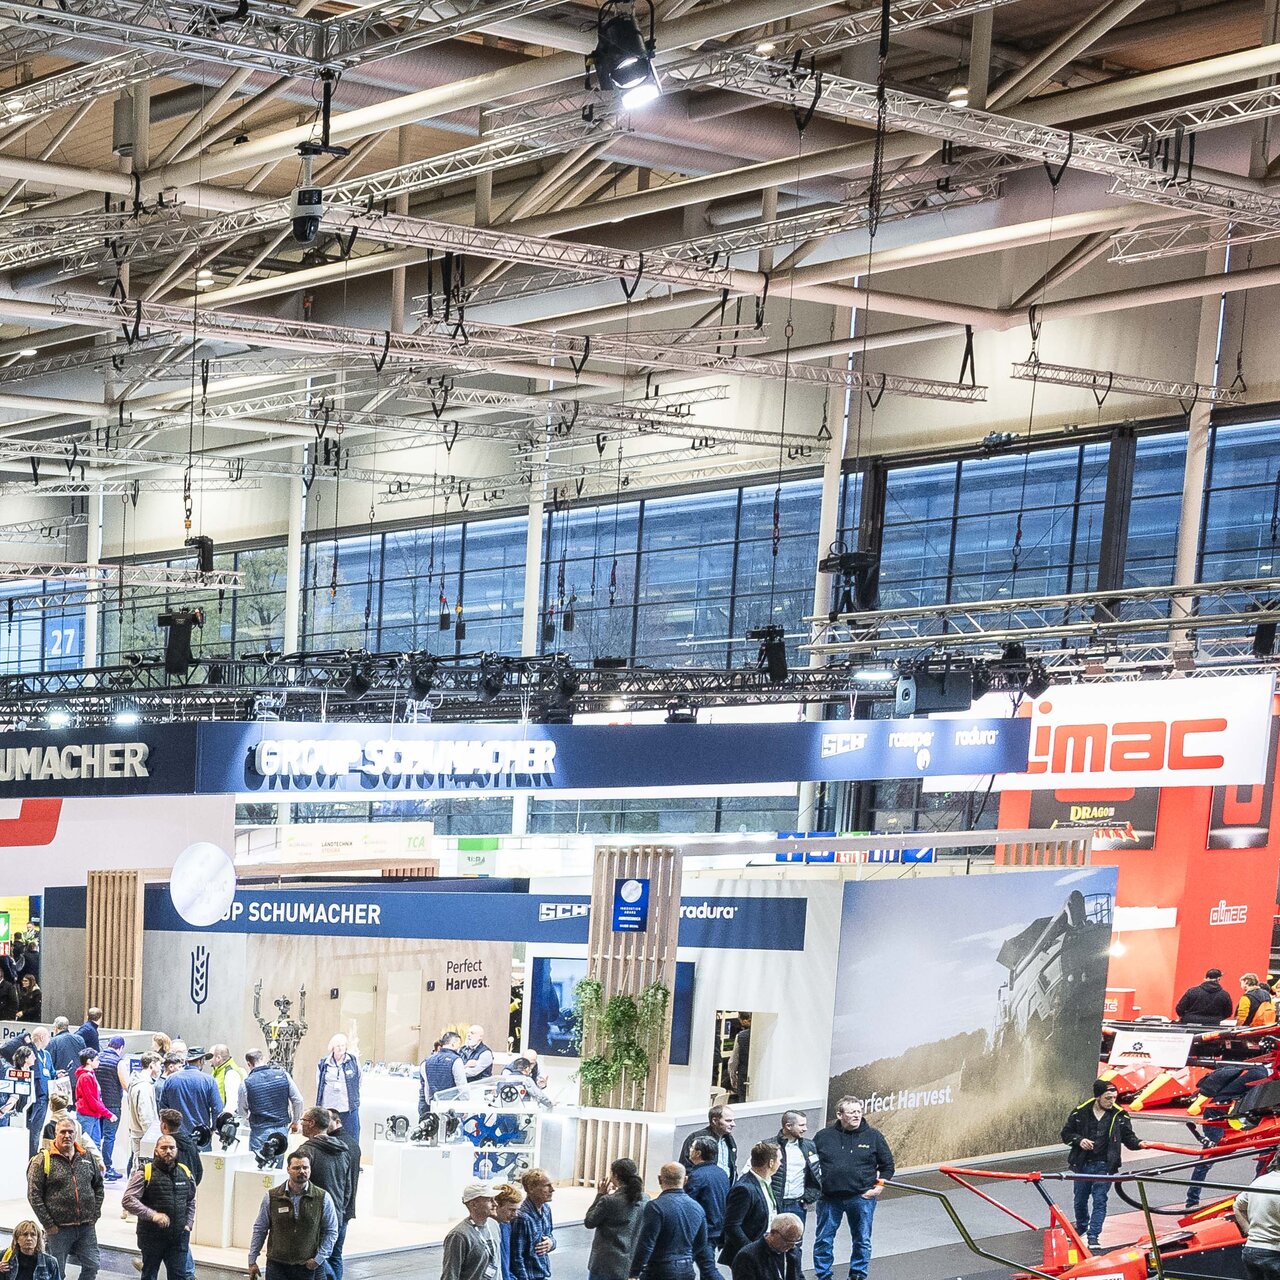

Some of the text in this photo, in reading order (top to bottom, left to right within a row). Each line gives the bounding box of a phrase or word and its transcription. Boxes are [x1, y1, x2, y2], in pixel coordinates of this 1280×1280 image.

[51, 629, 75, 655] 27
[256, 739, 557, 776] GROUP SCHUMACHER
[247, 902, 381, 926] SCHUMACHER
[446, 958, 483, 974] Perfect
[446, 975, 490, 991] Harvest.
[898, 1085, 954, 1109] Harvest.
